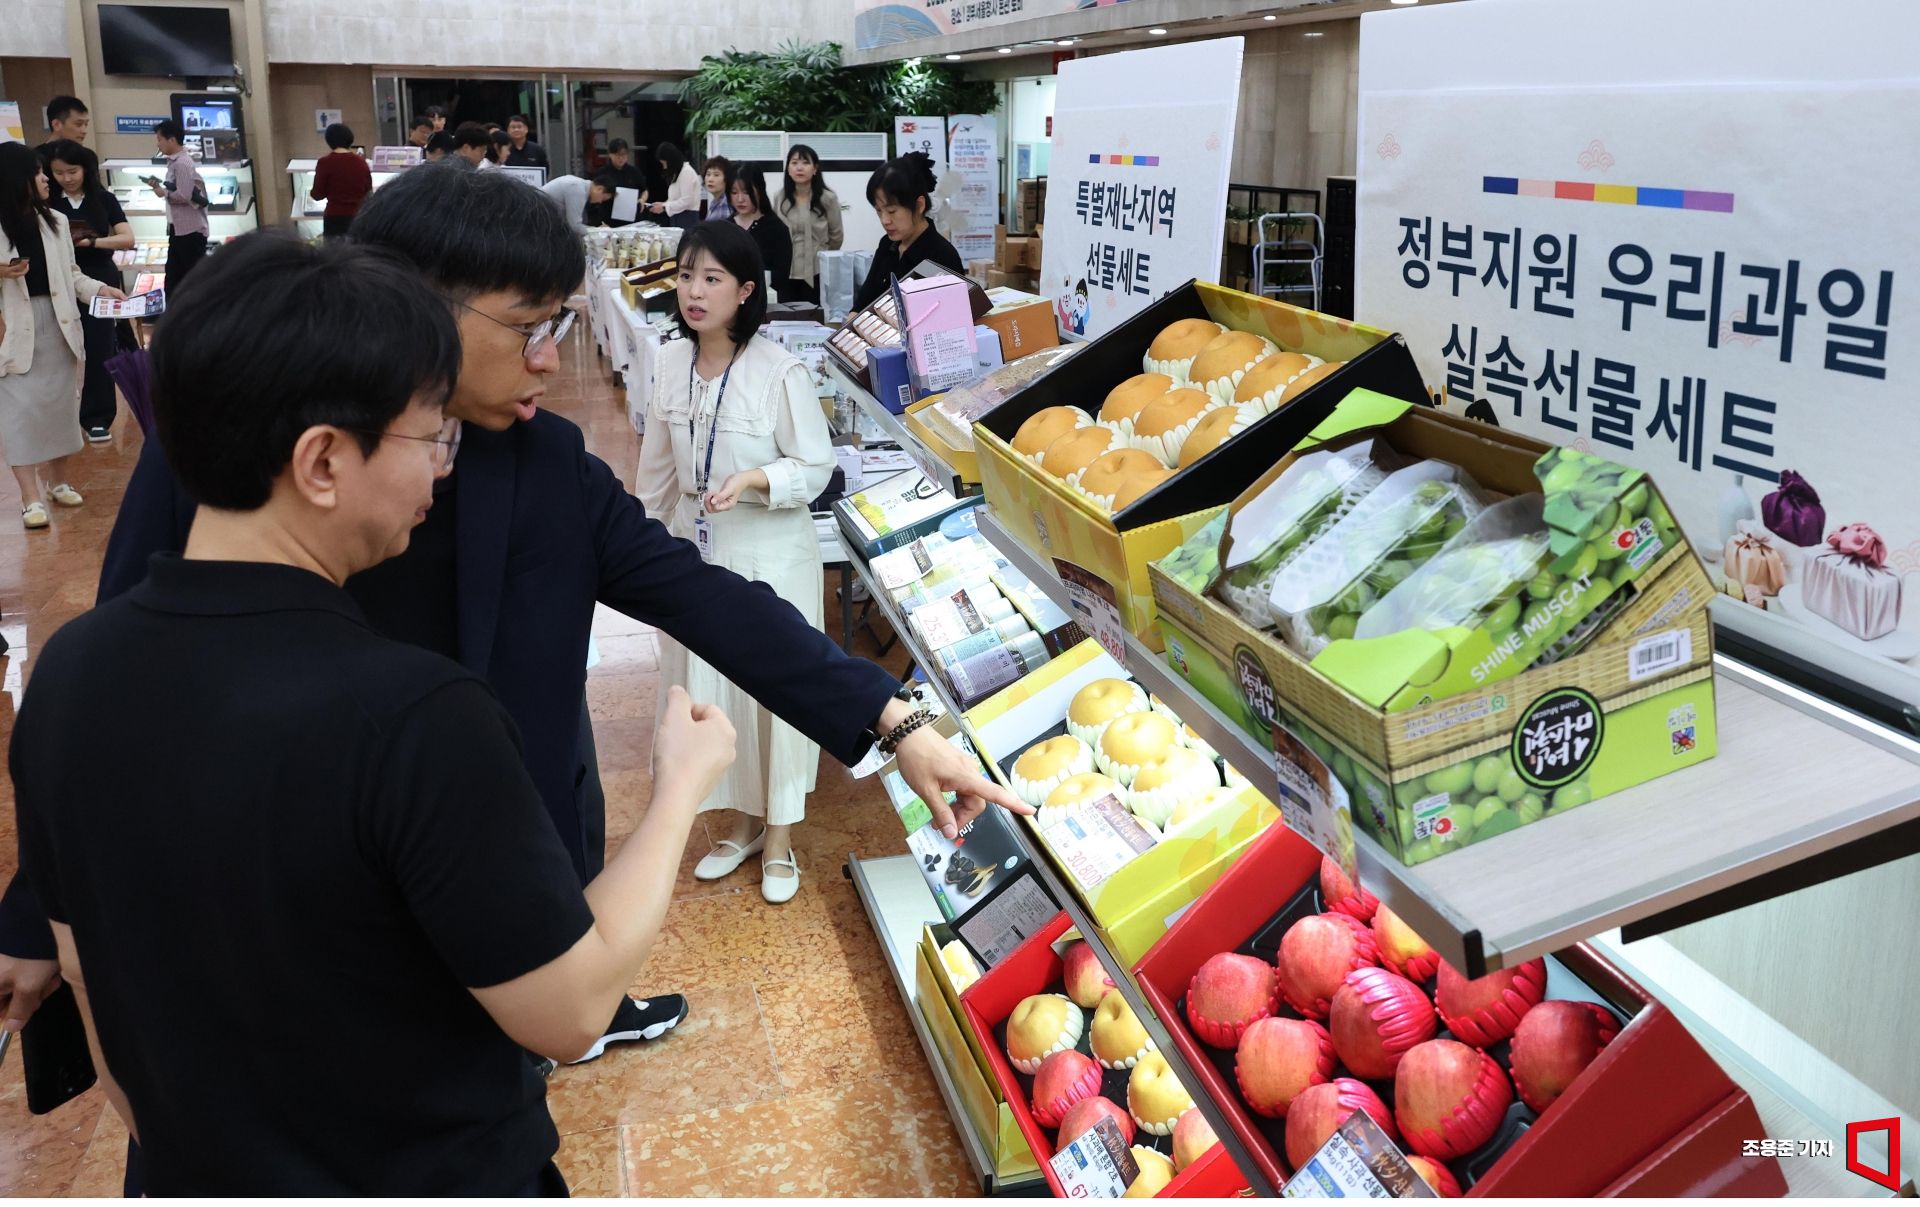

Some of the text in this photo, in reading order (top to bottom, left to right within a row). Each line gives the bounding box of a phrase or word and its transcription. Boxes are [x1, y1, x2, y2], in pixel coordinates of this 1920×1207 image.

[1075, 181, 1176, 238] 특별재난지역
[1086, 242, 1151, 296] 선물세트
[1397, 216, 1894, 381] 정부지원 우리과일
[1441, 323, 1781, 480] 실속선물세트
[1470, 632, 1524, 684] SHINE
[1521, 571, 1593, 639] MUSCAT
[1067, 850, 1103, 887] 30,800
[1329, 1136, 1392, 1198] 실속 사과 선물
